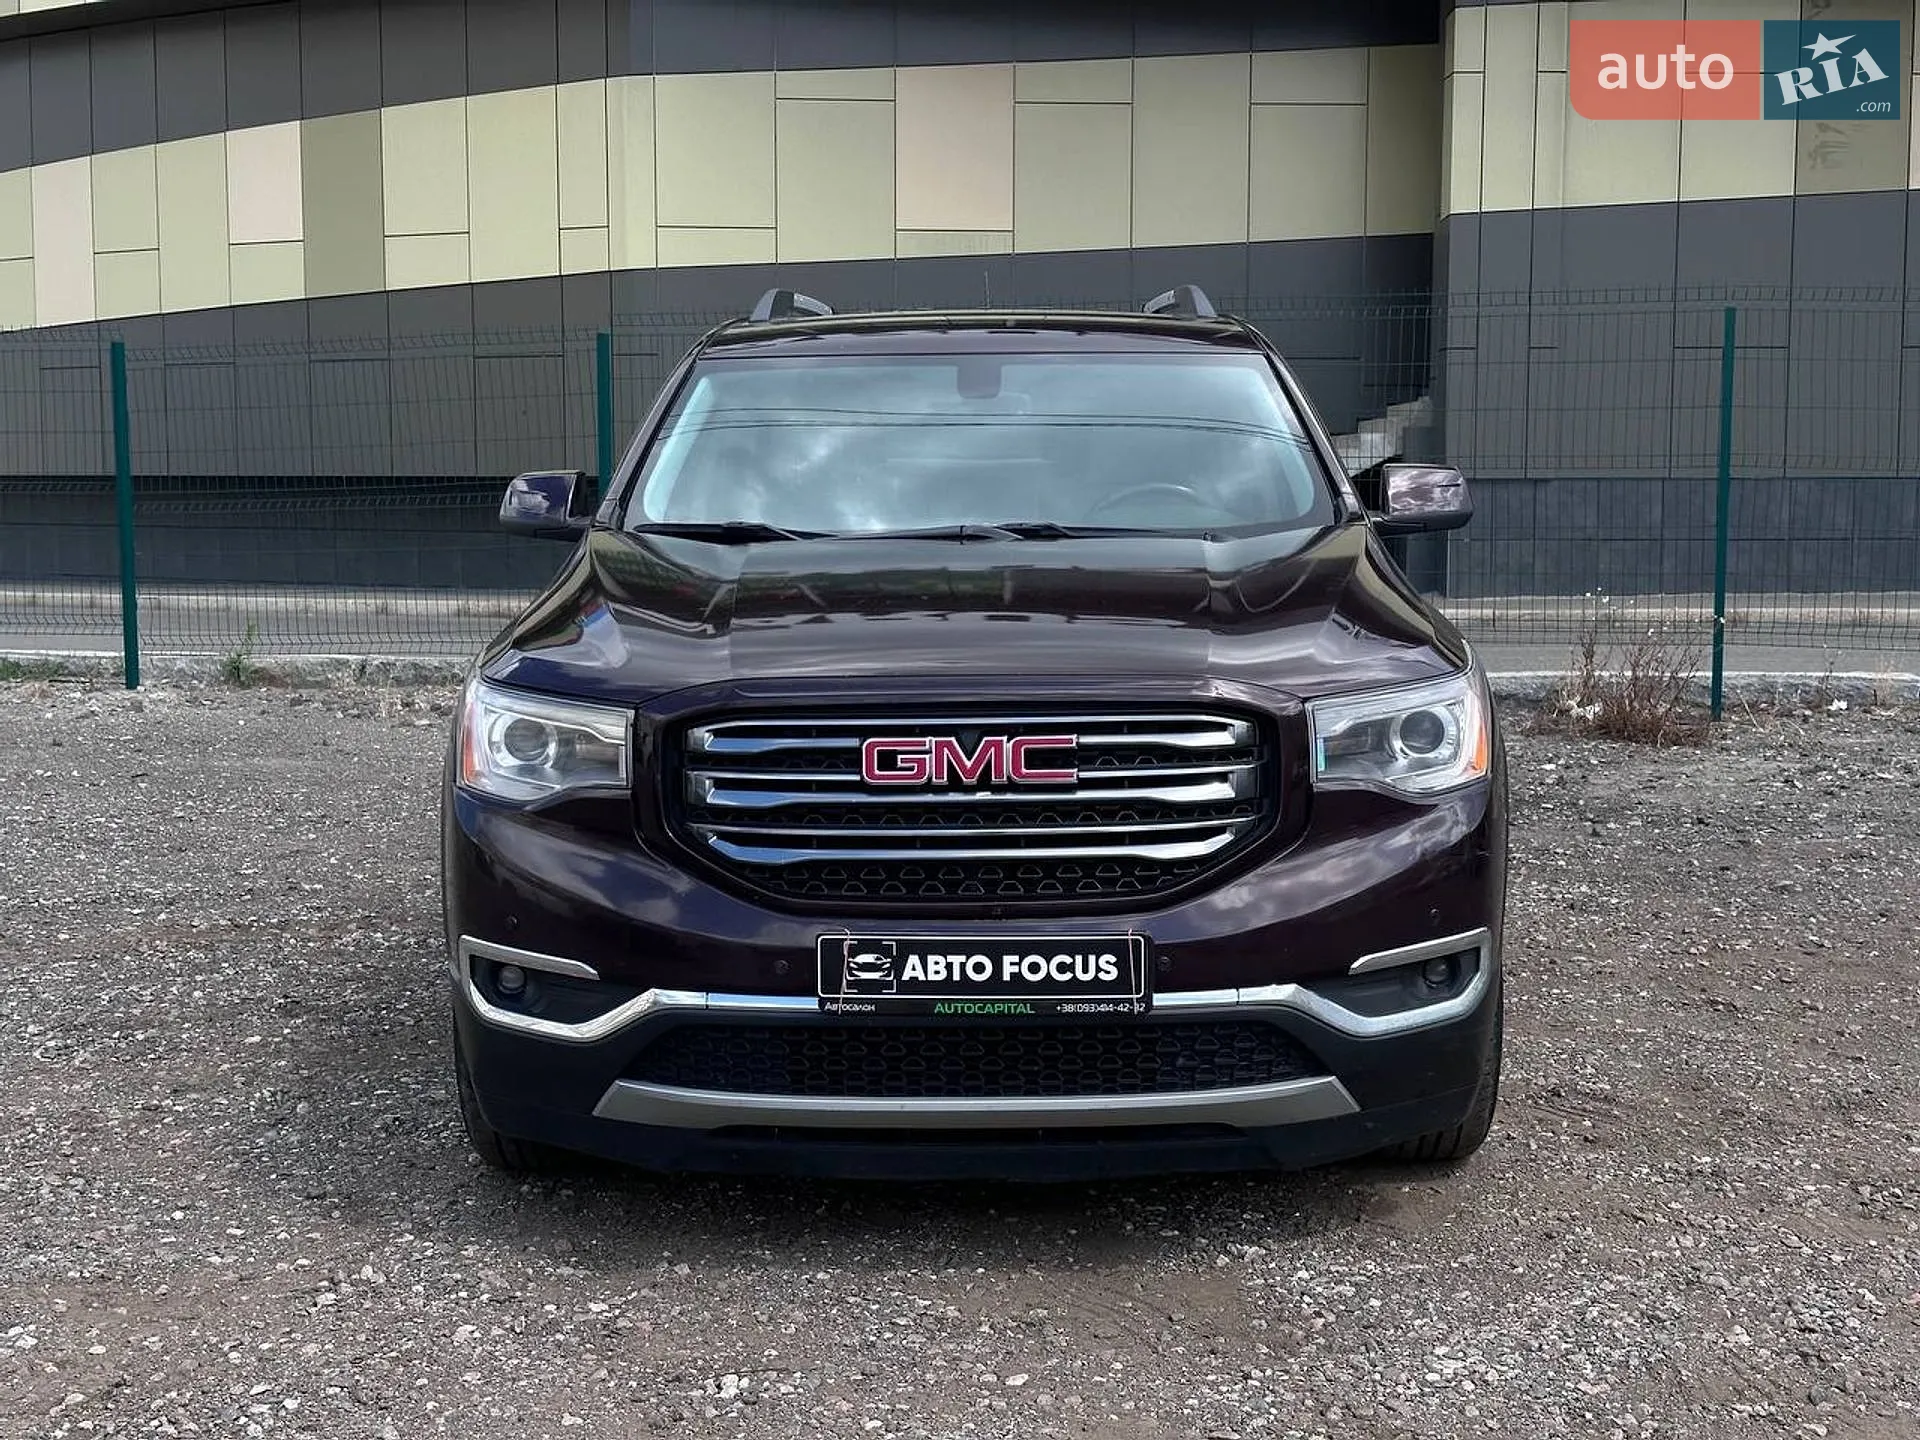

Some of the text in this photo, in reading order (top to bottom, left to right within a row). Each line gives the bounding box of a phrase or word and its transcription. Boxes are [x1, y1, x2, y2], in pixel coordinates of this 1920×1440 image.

[862, 734, 1079, 785] GMC
[901, 954, 1119, 982] АВТО FOCUS
[934, 1003, 1035, 1014] AUTOCAPITAL
